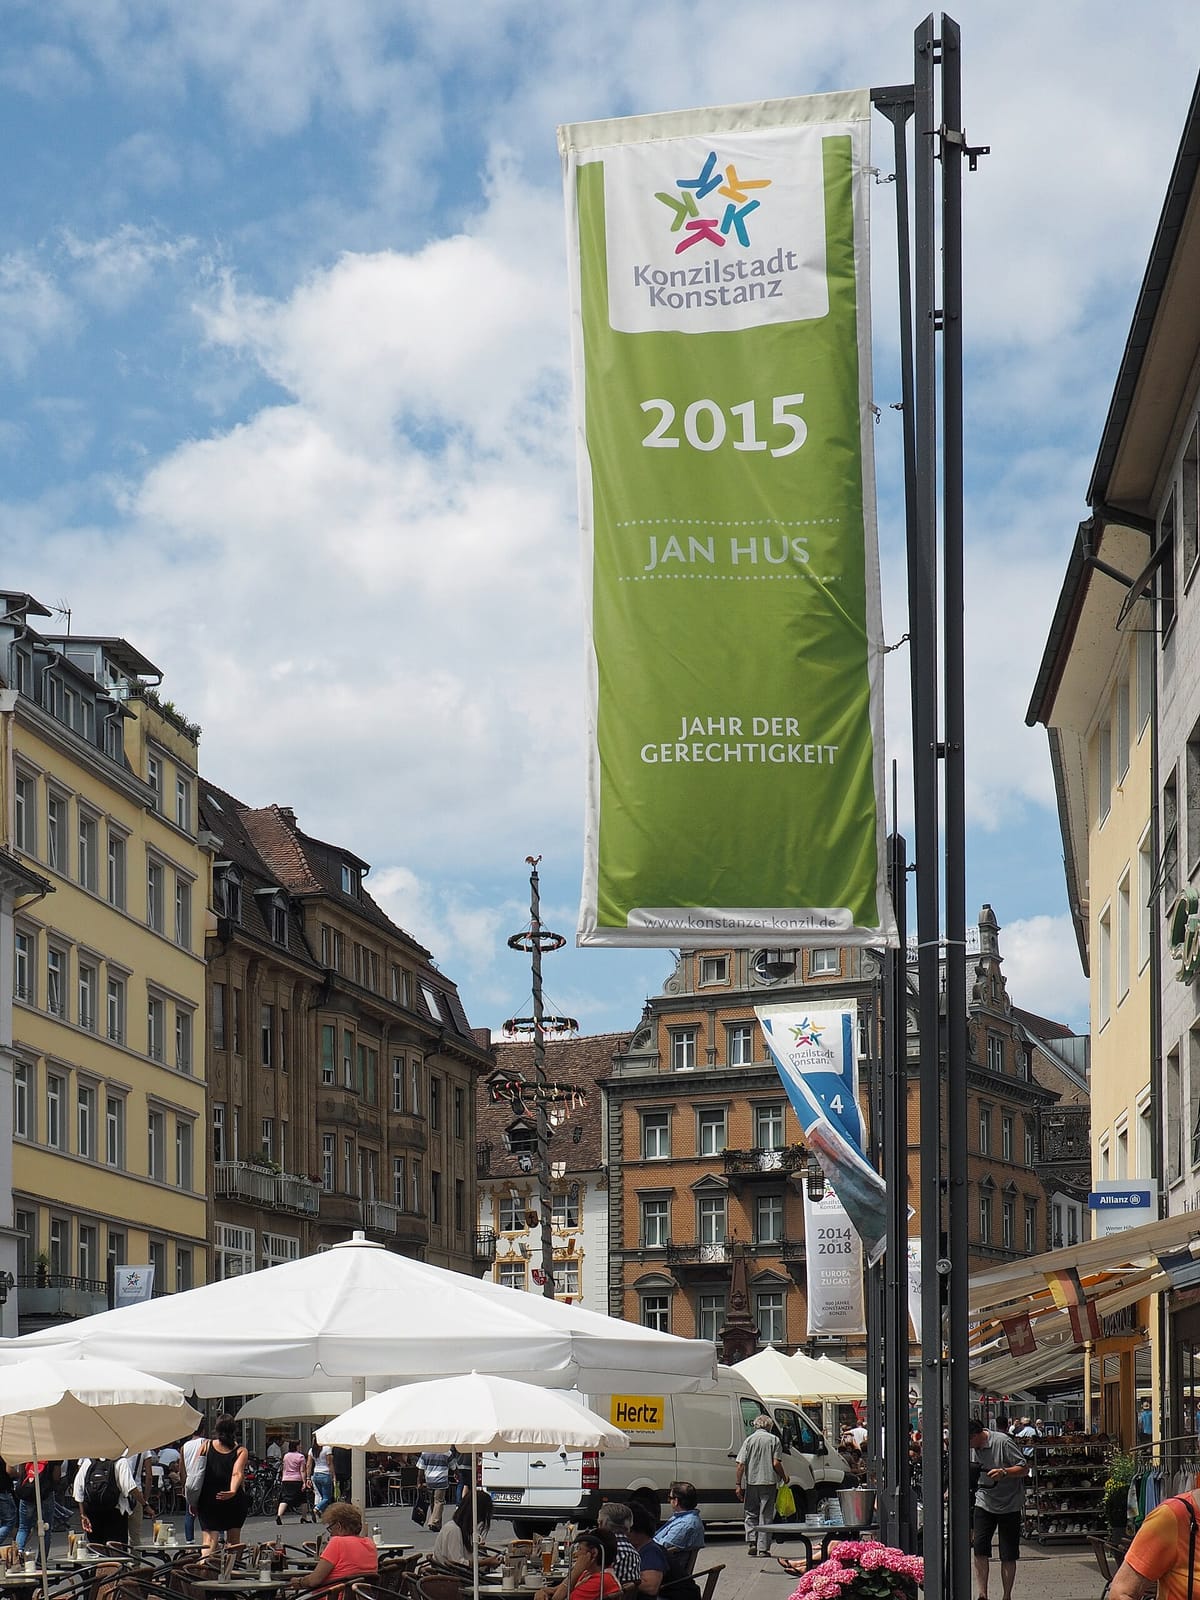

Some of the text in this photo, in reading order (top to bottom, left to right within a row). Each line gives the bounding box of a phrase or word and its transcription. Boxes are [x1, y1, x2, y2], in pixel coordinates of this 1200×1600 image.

[634, 247, 798, 287] Konzilstadt
[649, 278, 783, 309] Konstanz
[640, 392, 808, 458] 2015
[644, 535, 810, 571] JAN HUS
[679, 716, 800, 740] JAHR DER
[640, 742, 839, 765] GERECHTIGKEIT
[643, 914, 836, 930] www.konstanzer-konzil.de
[789, 1048, 835, 1060] onzilstadt
[793, 1057, 831, 1067] onstan
[1100, 1196, 1128, 1204] Allianz
[817, 1228, 852, 1240] 2014
[818, 1241, 852, 1254] 2018
[821, 1270, 851, 1278] EUROPA
[821, 1278, 850, 1286] ZU GAST
[616, 1403, 658, 1423] Hertz
